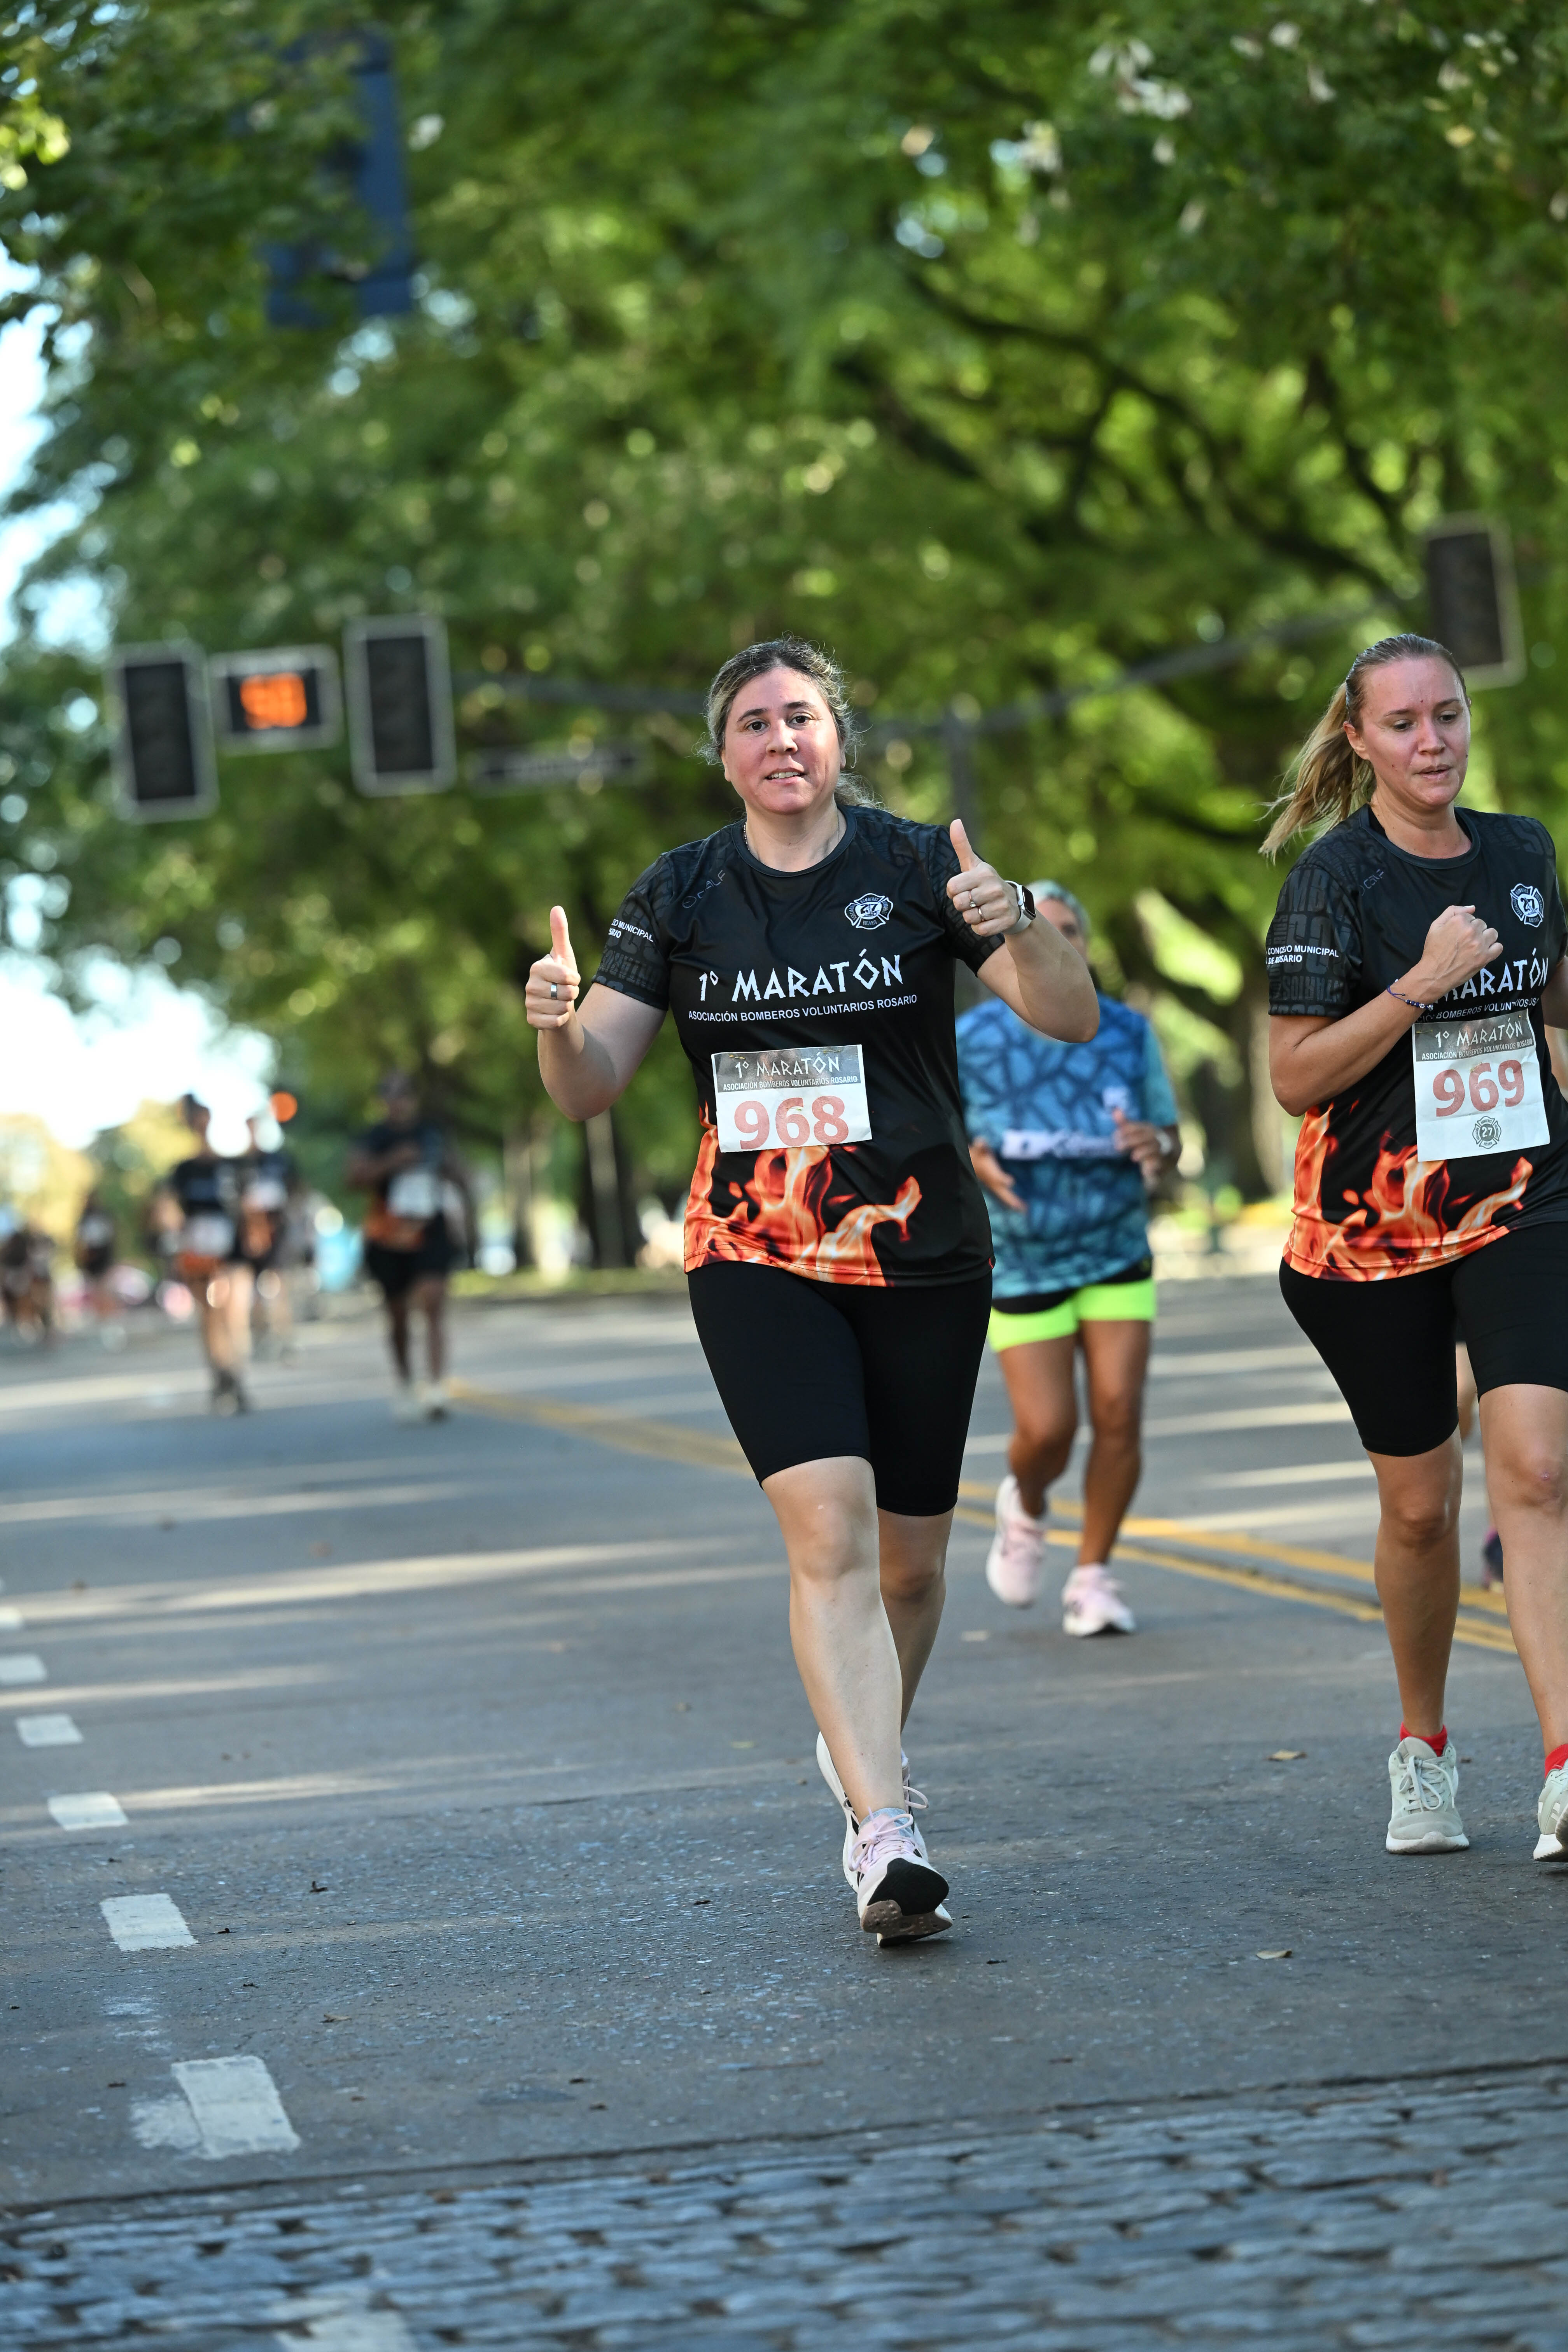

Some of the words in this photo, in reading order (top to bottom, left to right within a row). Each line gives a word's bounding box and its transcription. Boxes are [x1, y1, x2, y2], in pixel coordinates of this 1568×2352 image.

[860, 903, 878, 914] 27
[1520, 898, 1535, 912] 27
[618, 920, 653, 942] MUNICIPAL
[1294, 945, 1339, 957] MUNICIPAL
[732, 948, 903, 1002] MARATÓN
[689, 1010, 738, 1022] ASOCIACIÓN
[740, 1009, 800, 1021] BOMBEROS
[802, 1000, 874, 1017] VOLUNTARIOS
[877, 994, 917, 1008] ROSARIO
[1436, 1006, 1482, 1019] BOMBEROS
[1456, 1017, 1523, 1046] MARATÓN
[1458, 1047, 1482, 1058] BOMBEROS
[1484, 1043, 1516, 1054] VOLUNTARIOS
[1517, 1038, 1533, 1048] ROSARIO
[757, 1051, 840, 1076] MARATÓN
[723, 1081, 758, 1091] ASOCIACIÓN
[759, 1080, 789, 1088] BOMBEROS
[791, 1078, 829, 1087] VOLUNTARIOS
[831, 1076, 858, 1084] ROSARIO
[1433, 1059, 1524, 1117] 969
[734, 1096, 849, 1150] 968
[1482, 1127, 1493, 1138] 27
